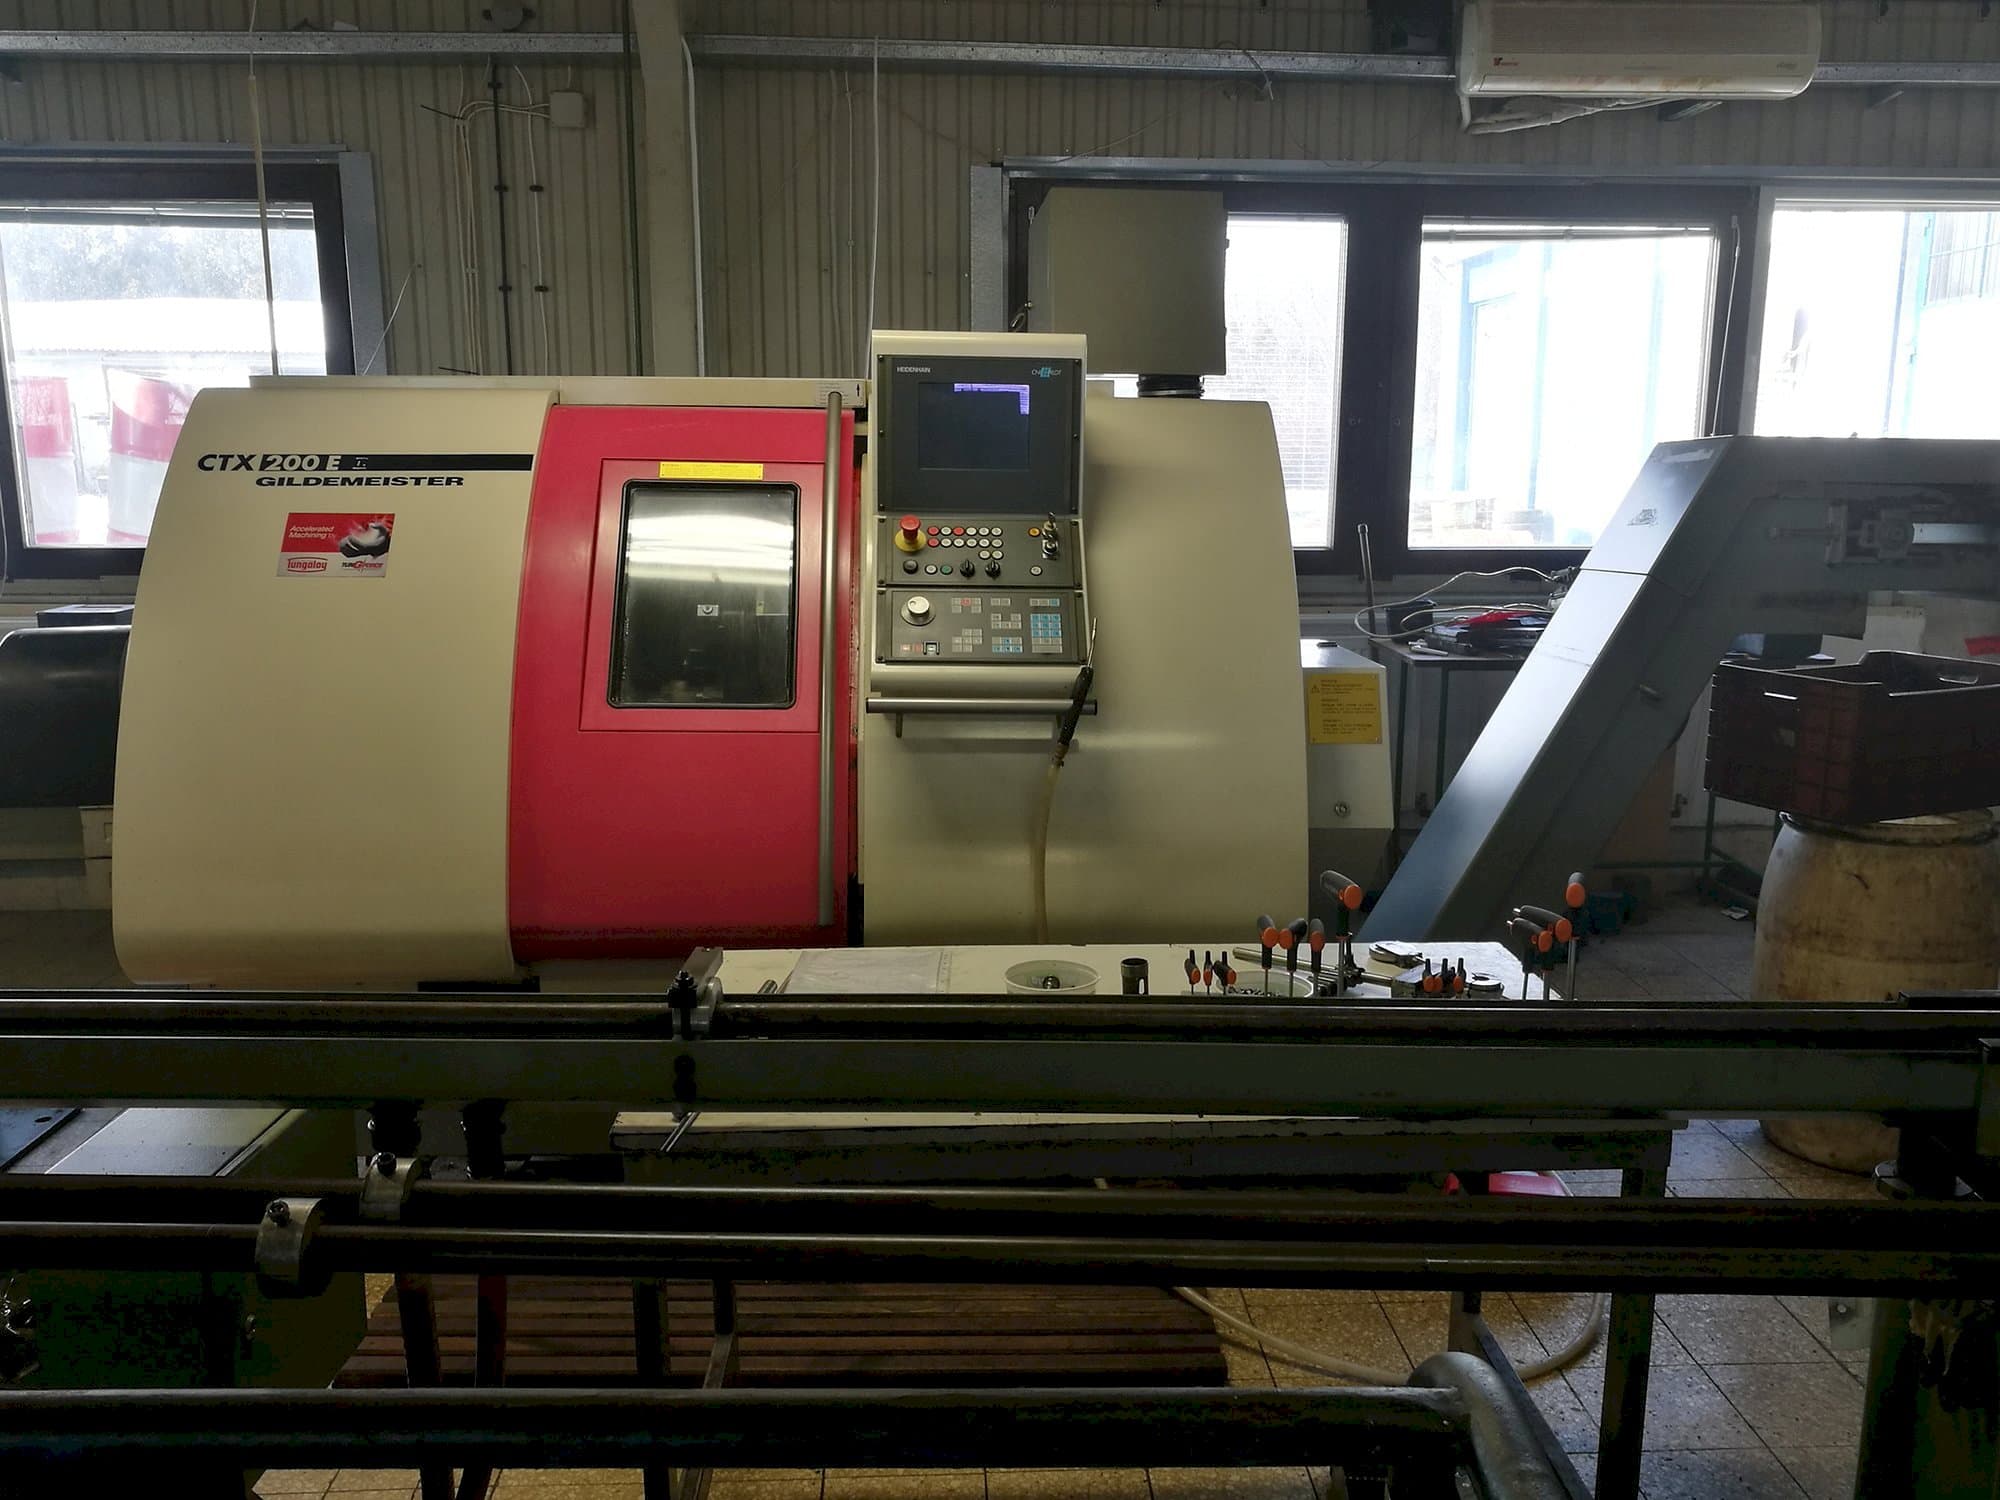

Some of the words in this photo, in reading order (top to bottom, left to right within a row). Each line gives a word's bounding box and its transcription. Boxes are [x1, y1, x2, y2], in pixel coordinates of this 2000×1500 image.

[197, 454, 256, 472] CTX
[264, 455, 321, 471] 200
[326, 455, 342, 471] E
[255, 476, 464, 487] GILDEMEISTER
[289, 525, 335, 533] Accelerated
[287, 532, 327, 540] Machining
